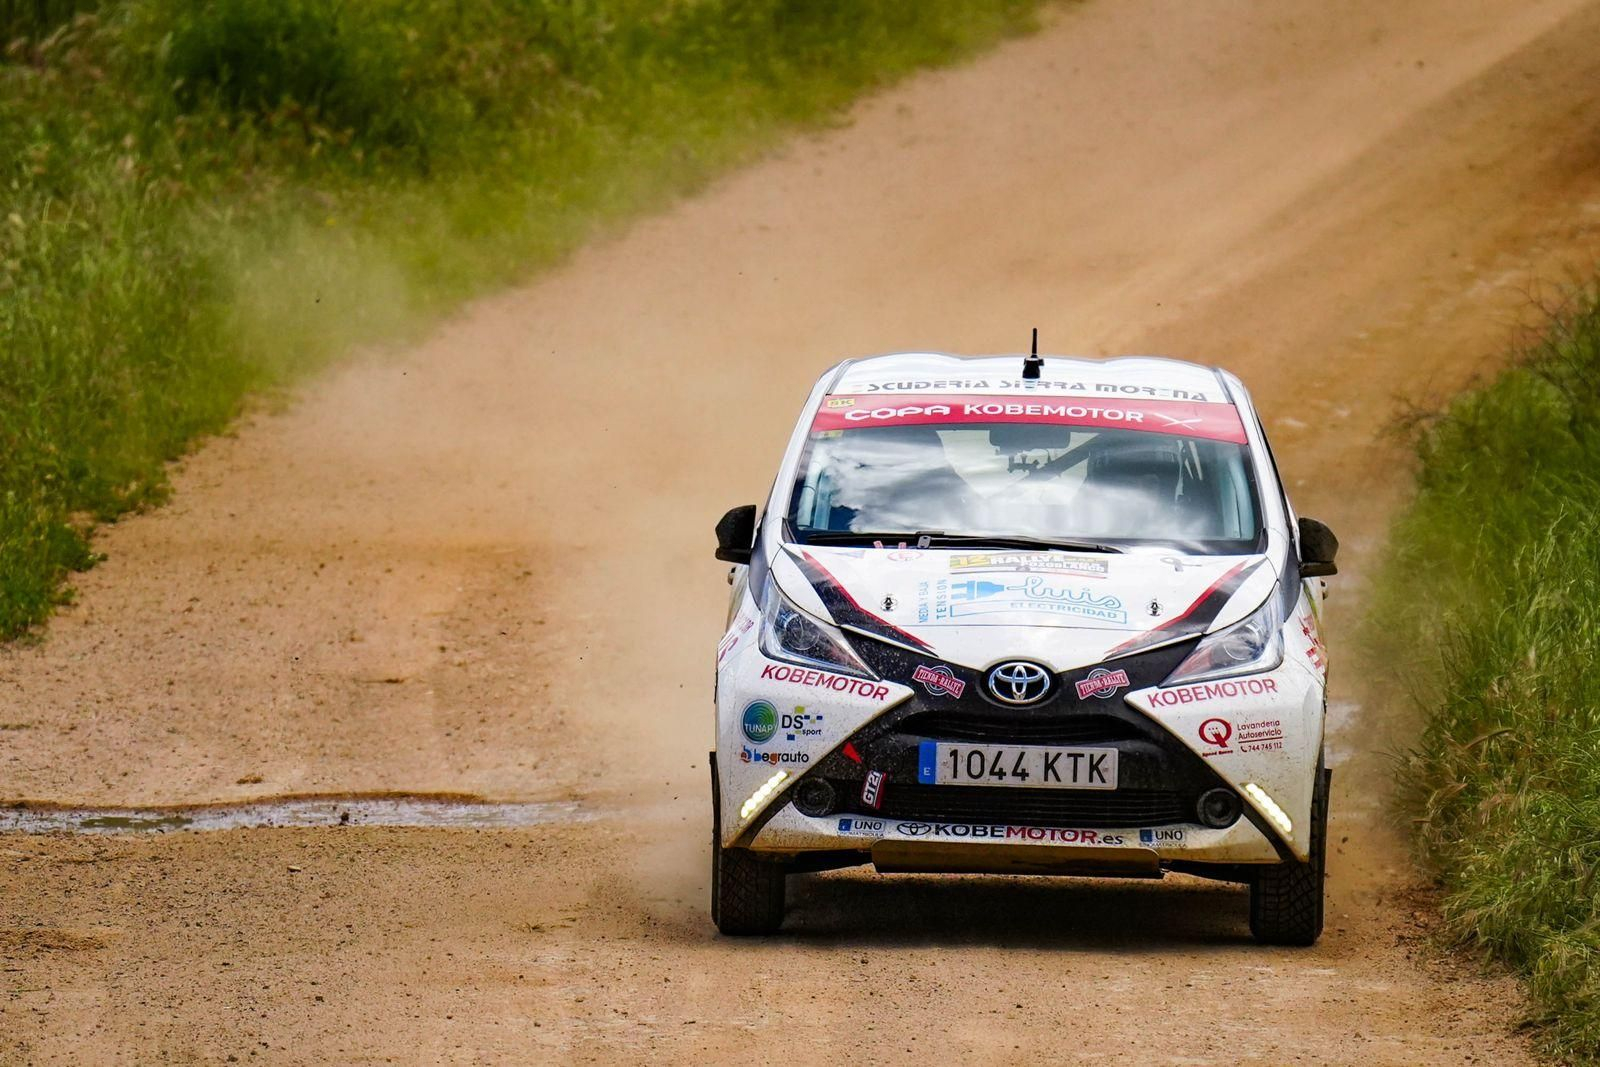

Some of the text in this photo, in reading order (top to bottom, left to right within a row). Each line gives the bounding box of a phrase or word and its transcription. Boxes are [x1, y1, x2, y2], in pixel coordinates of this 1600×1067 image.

[852, 380, 989, 392] SCUDERIA
[845, 404, 1143, 423] COPA KOBEMOTOR
[936, 579, 947, 620] TENSION
[1010, 601, 1118, 619] ELECTRICIDAD
[761, 664, 889, 701] KOBEMOTOR
[1147, 678, 1278, 708] KOBEMOTOR
[744, 723, 774, 733] TUNAP
[782, 715, 804, 729] DS
[802, 729, 822, 737] sport
[1238, 729, 1282, 740] Autoservicio
[754, 748, 809, 765] begrauto
[924, 749, 1107, 784] E 1044 KTK
[854, 820, 882, 831] UNO
[934, 824, 1123, 845] KOBEMOTOR.es
[1155, 830, 1183, 841] UNO
